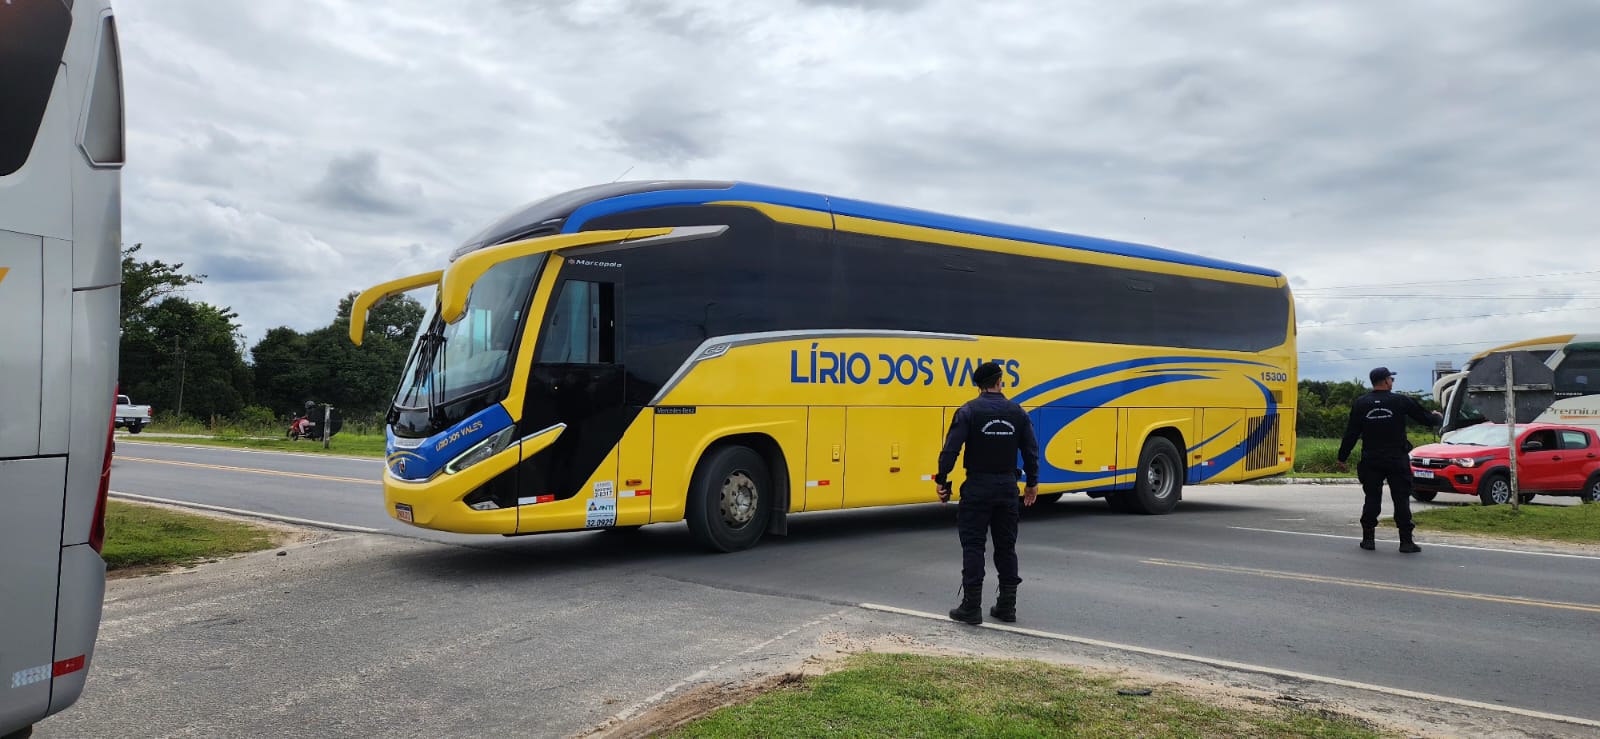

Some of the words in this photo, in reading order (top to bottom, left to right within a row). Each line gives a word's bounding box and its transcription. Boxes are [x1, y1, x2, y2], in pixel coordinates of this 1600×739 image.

[576, 259, 622, 268] Marcopolo
[791, 342, 871, 384] LÍRIO
[878, 353, 934, 386] DOS
[942, 357, 1020, 387] VAS
[1260, 372, 1287, 383] 15300
[460, 420, 484, 436] VALES
